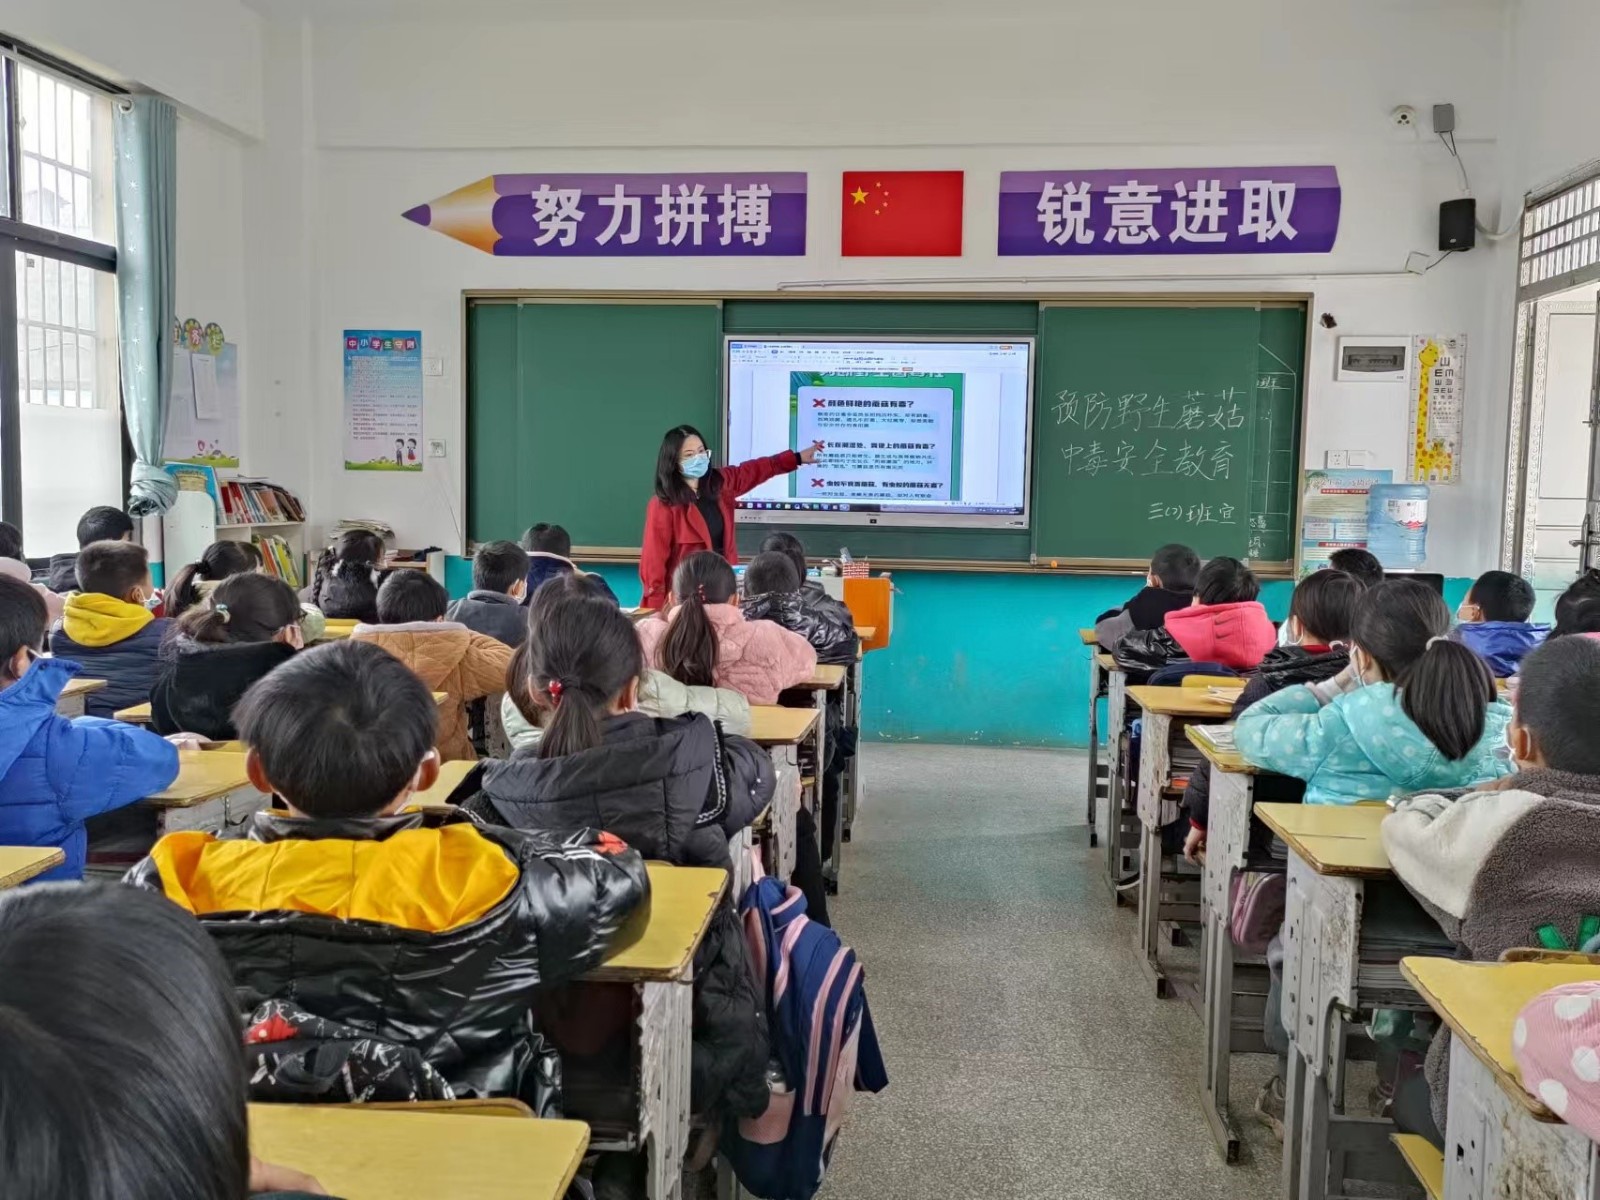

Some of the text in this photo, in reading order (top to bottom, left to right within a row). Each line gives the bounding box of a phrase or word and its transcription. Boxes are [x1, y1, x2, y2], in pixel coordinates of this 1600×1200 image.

[531, 184, 772, 247] 努力拼搏
[1036, 179, 1299, 246] 锐意进取
[347, 337, 416, 350] 中小学生守则
[1051, 386, 1247, 431] 预防野生蘑菇
[1061, 439, 1233, 480] 中毒安全教育
